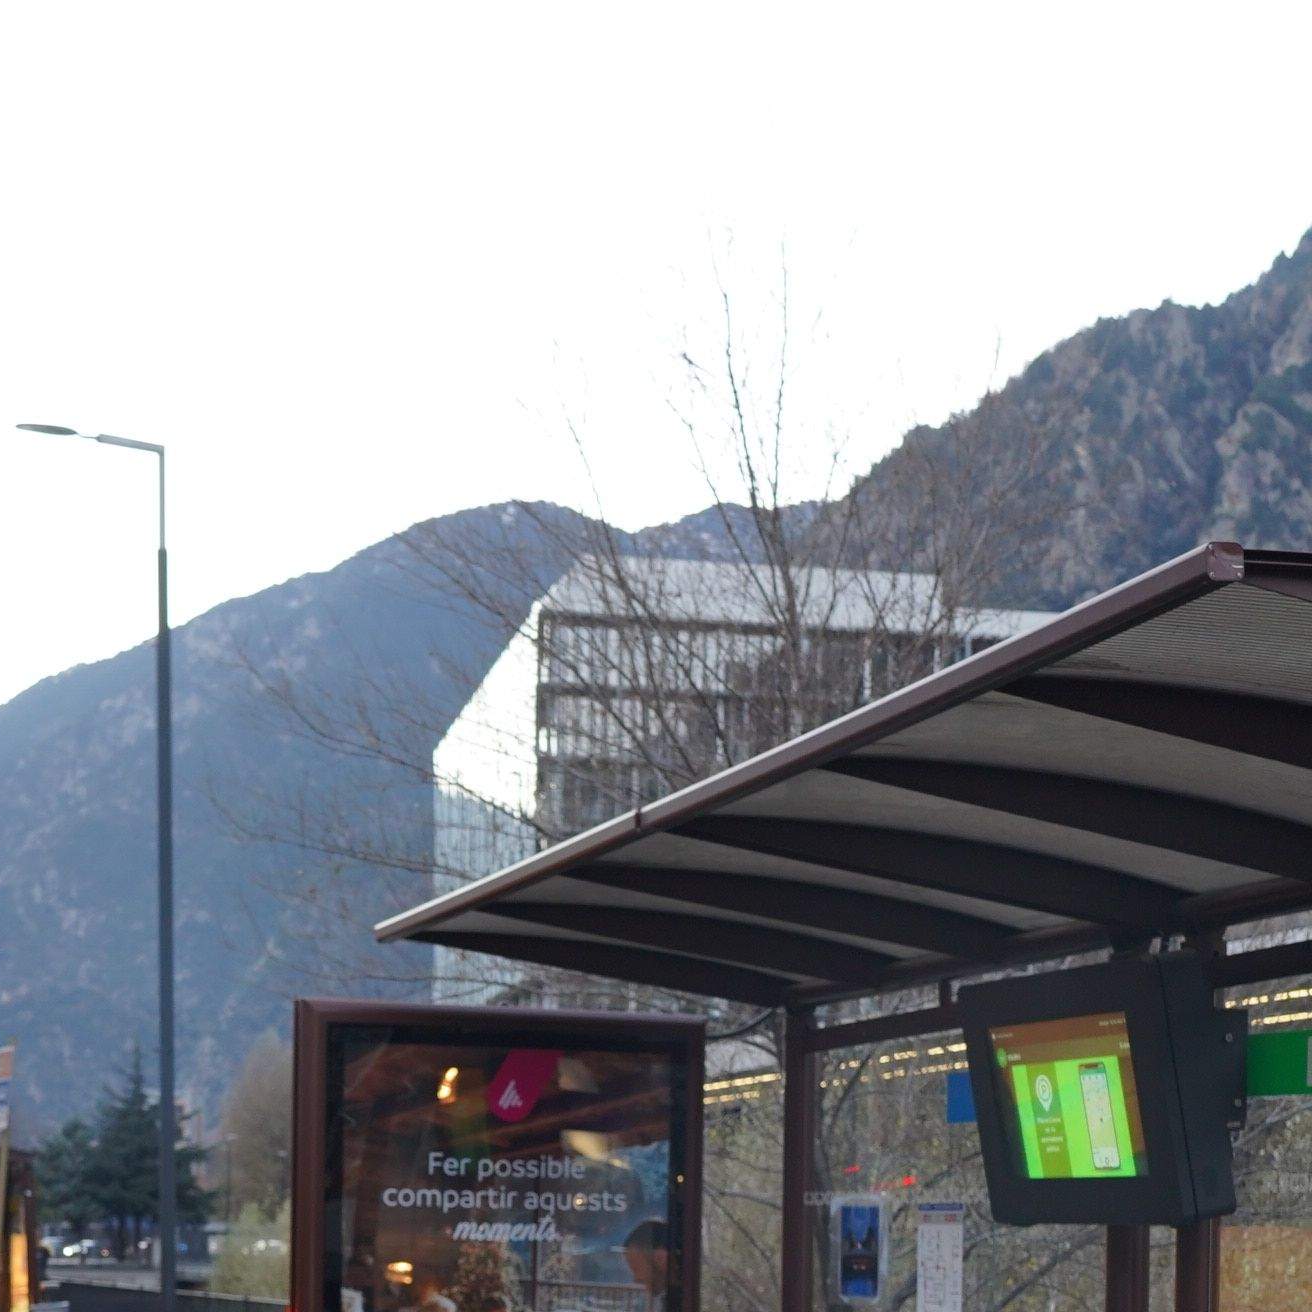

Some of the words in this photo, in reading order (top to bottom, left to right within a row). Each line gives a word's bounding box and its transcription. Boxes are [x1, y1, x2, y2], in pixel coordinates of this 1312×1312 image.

[428, 1152, 471, 1177] Fer
[477, 1154, 586, 1181] possible
[382, 1185, 516, 1214] compartir
[524, 1189, 628, 1217] aquests
